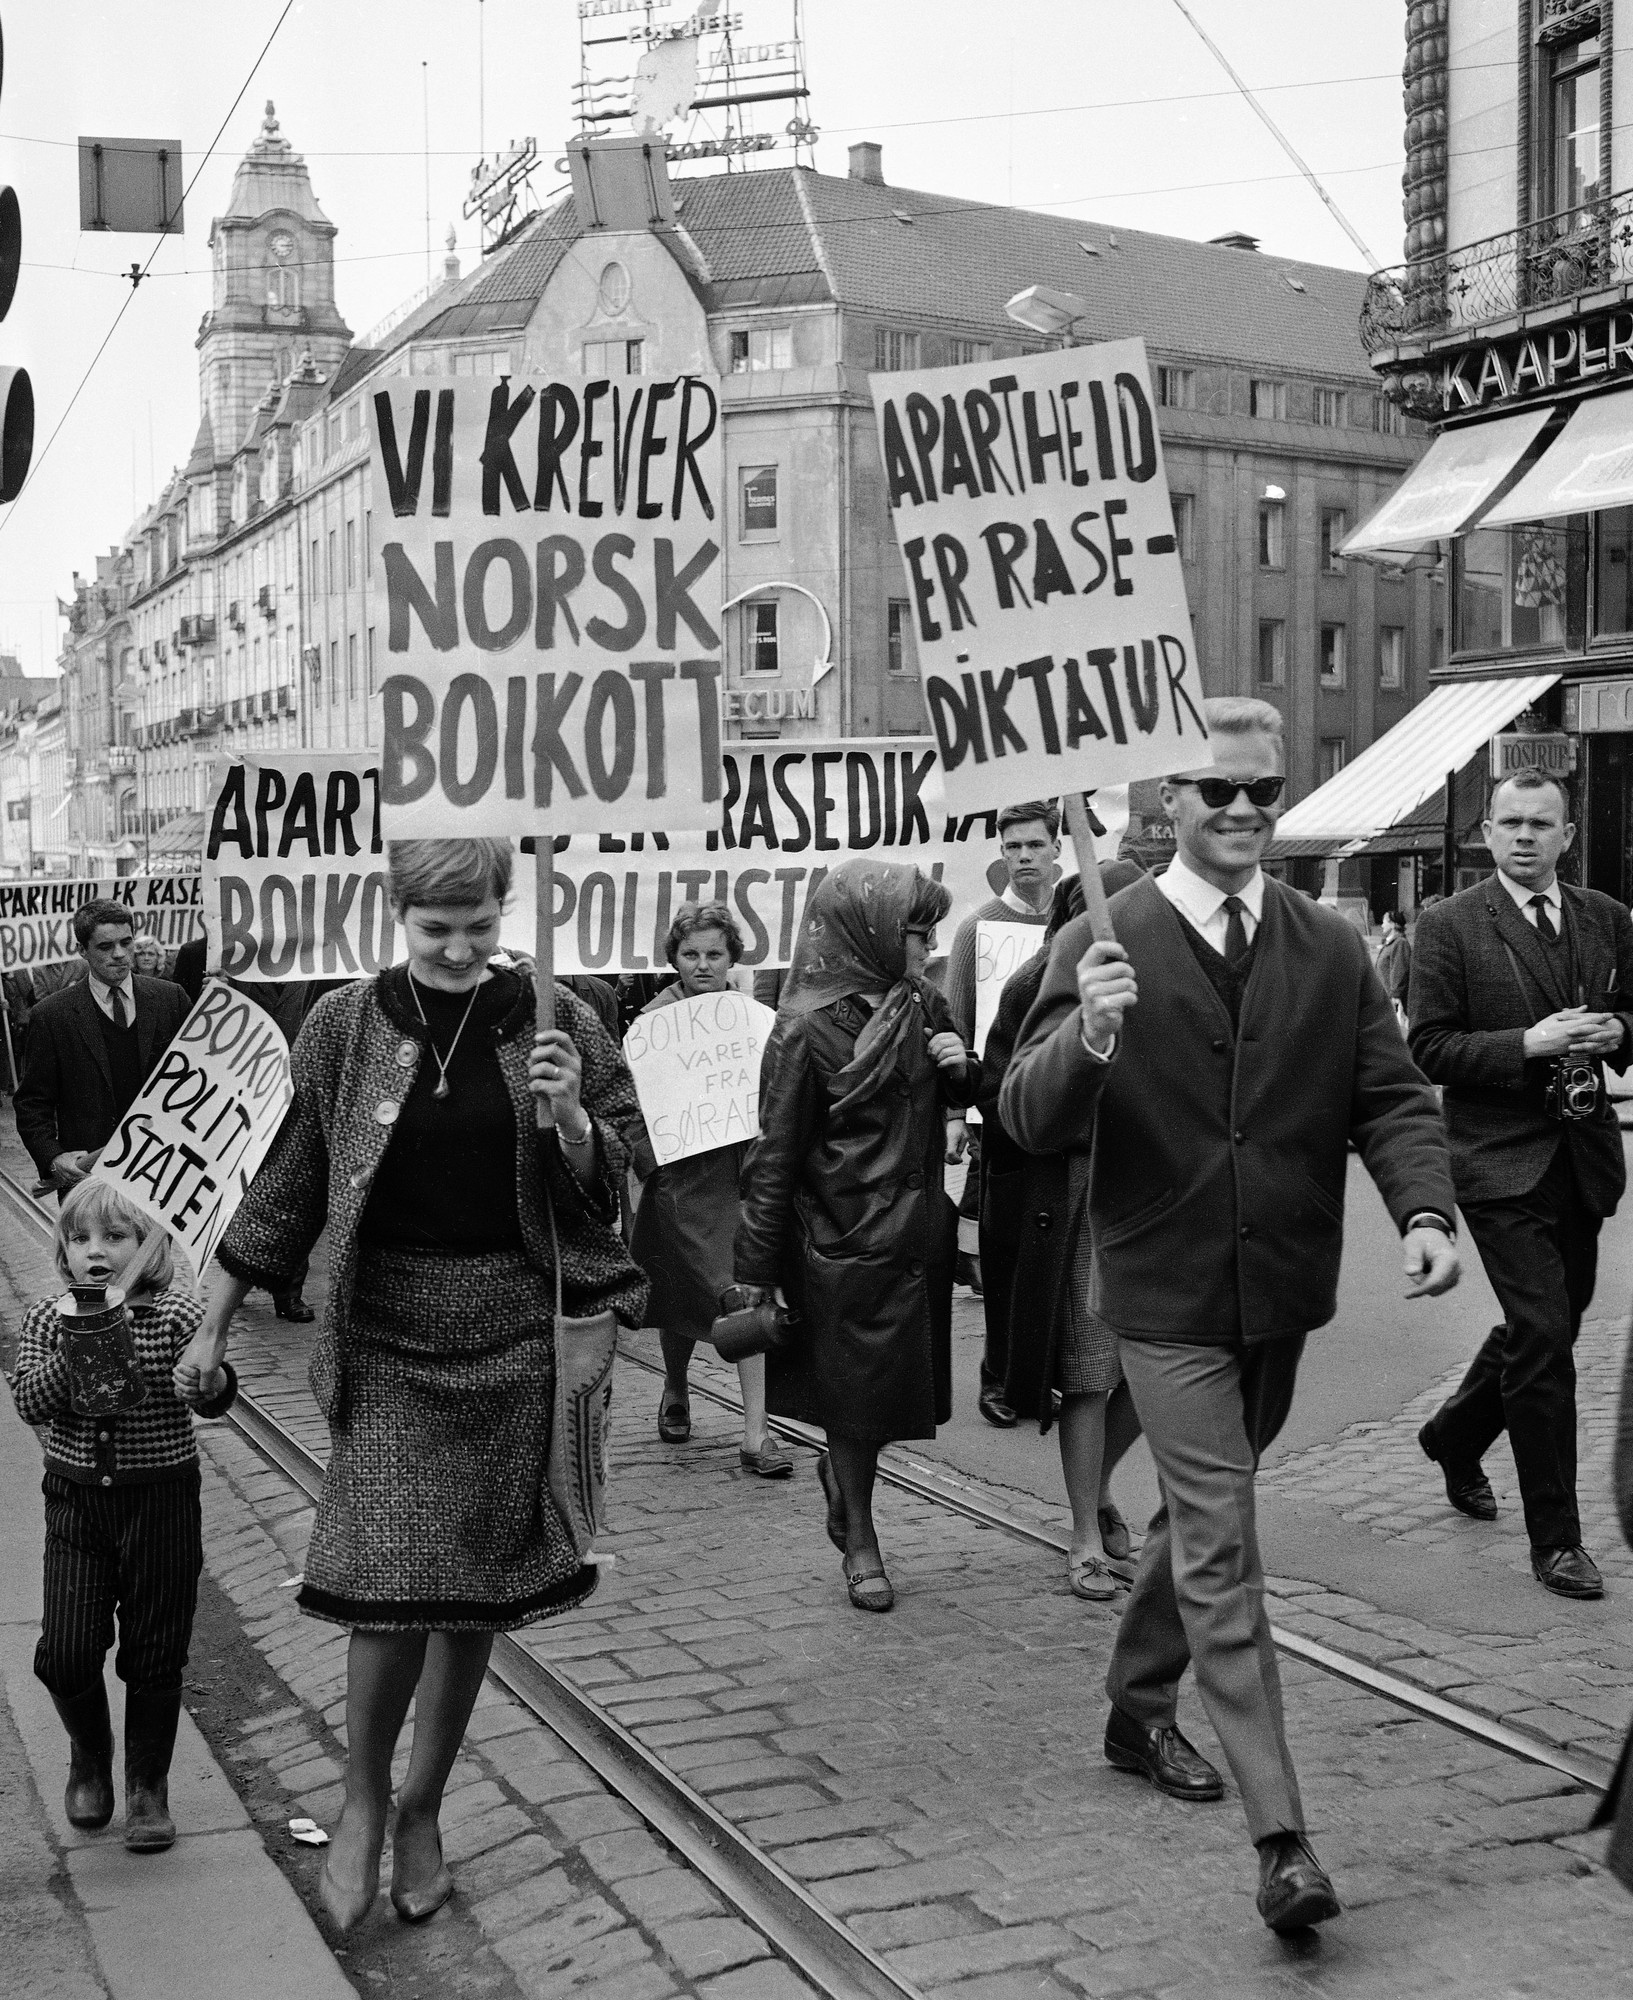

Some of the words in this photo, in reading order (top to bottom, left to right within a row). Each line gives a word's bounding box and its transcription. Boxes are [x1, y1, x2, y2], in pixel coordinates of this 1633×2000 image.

[374, 389, 454, 518] VI
[480, 376, 716, 521] KREVER
[883, 372, 1157, 508] APARTHEID
[381, 533, 721, 654] NORSK
[903, 533, 978, 642] ER
[979, 499, 1175, 609] RASE-
[379, 660, 721, 808] BOIKOTT
[926, 634, 1208, 771] DIKTATUR
[0, 882, 99, 918] PARTHEID
[220, 871, 395, 977] BOIKO
[677, 1037, 762, 1071] VARER
[706, 1068, 752, 1094] FRA
[103, 1113, 227, 1279] STATEN
